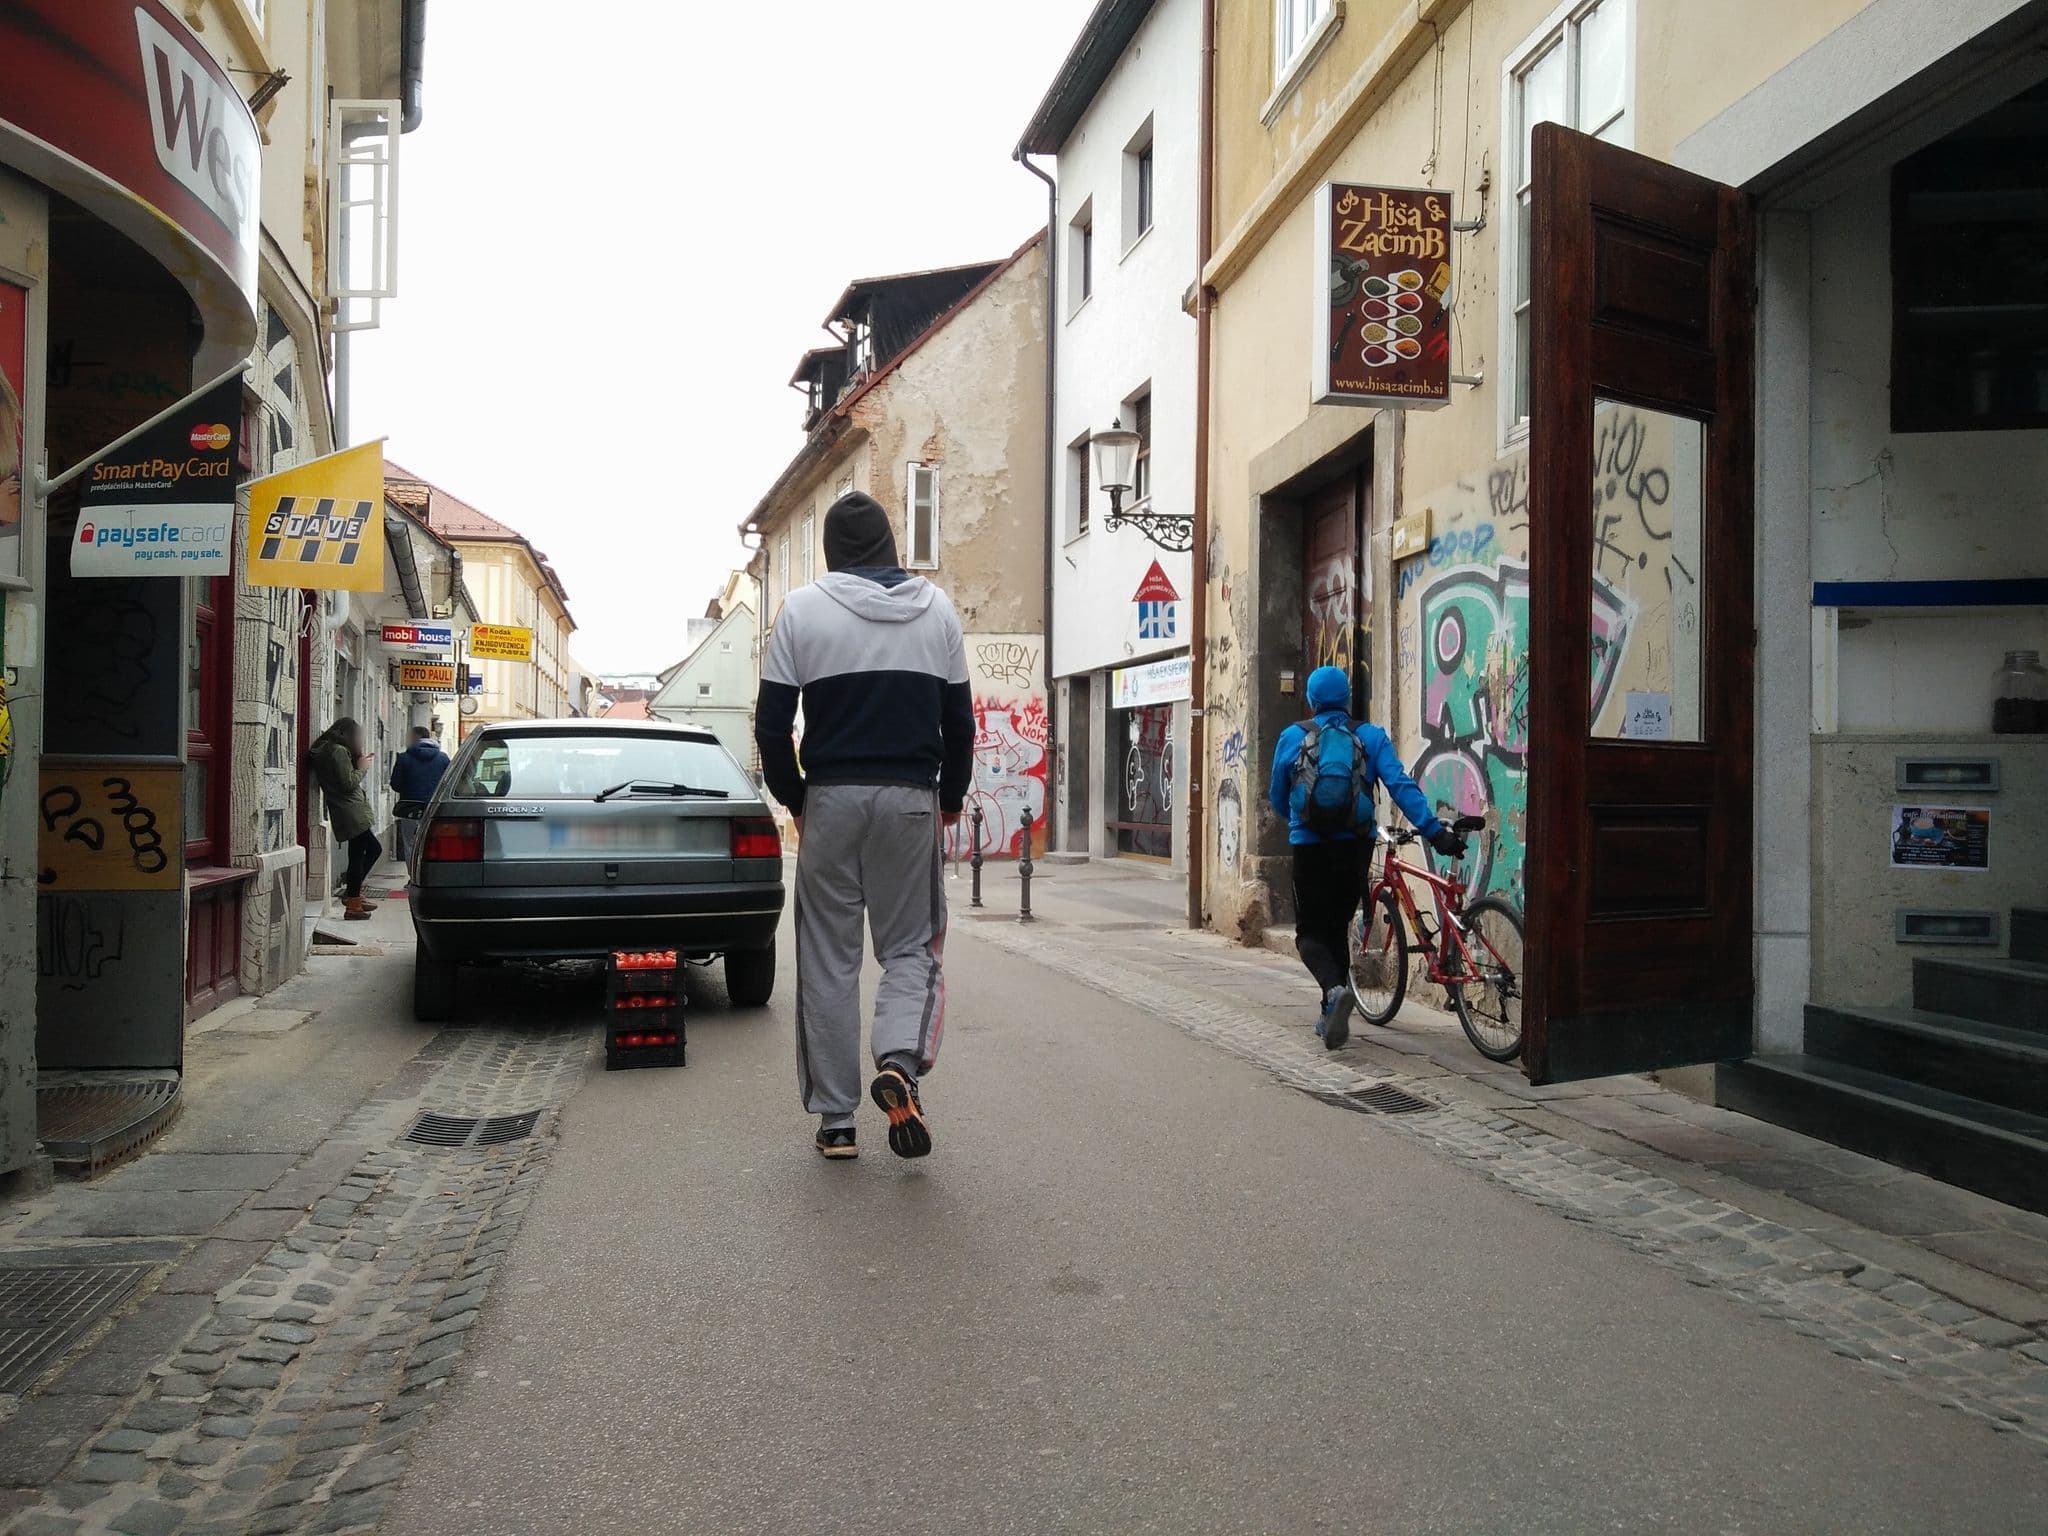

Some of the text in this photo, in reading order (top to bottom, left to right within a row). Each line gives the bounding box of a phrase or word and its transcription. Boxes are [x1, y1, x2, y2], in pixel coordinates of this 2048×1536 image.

[1335, 375, 1444, 395] www.hisazacimb.si
[190, 432, 231, 442] MasterCard
[93, 458, 230, 481] SmartPayCard
[267, 515, 361, 538] STAVE
[97, 522, 226, 548] paysafecard
[1428, 522, 1495, 567] GOOD
[134, 548, 224, 561] pay cash. pay safe.
[385, 629, 451, 642] mobi house
[489, 627, 512, 636] Kodak
[404, 667, 426, 680] FOTO
[429, 669, 453, 682] PAULI
[532, 806, 545, 814] ZX
